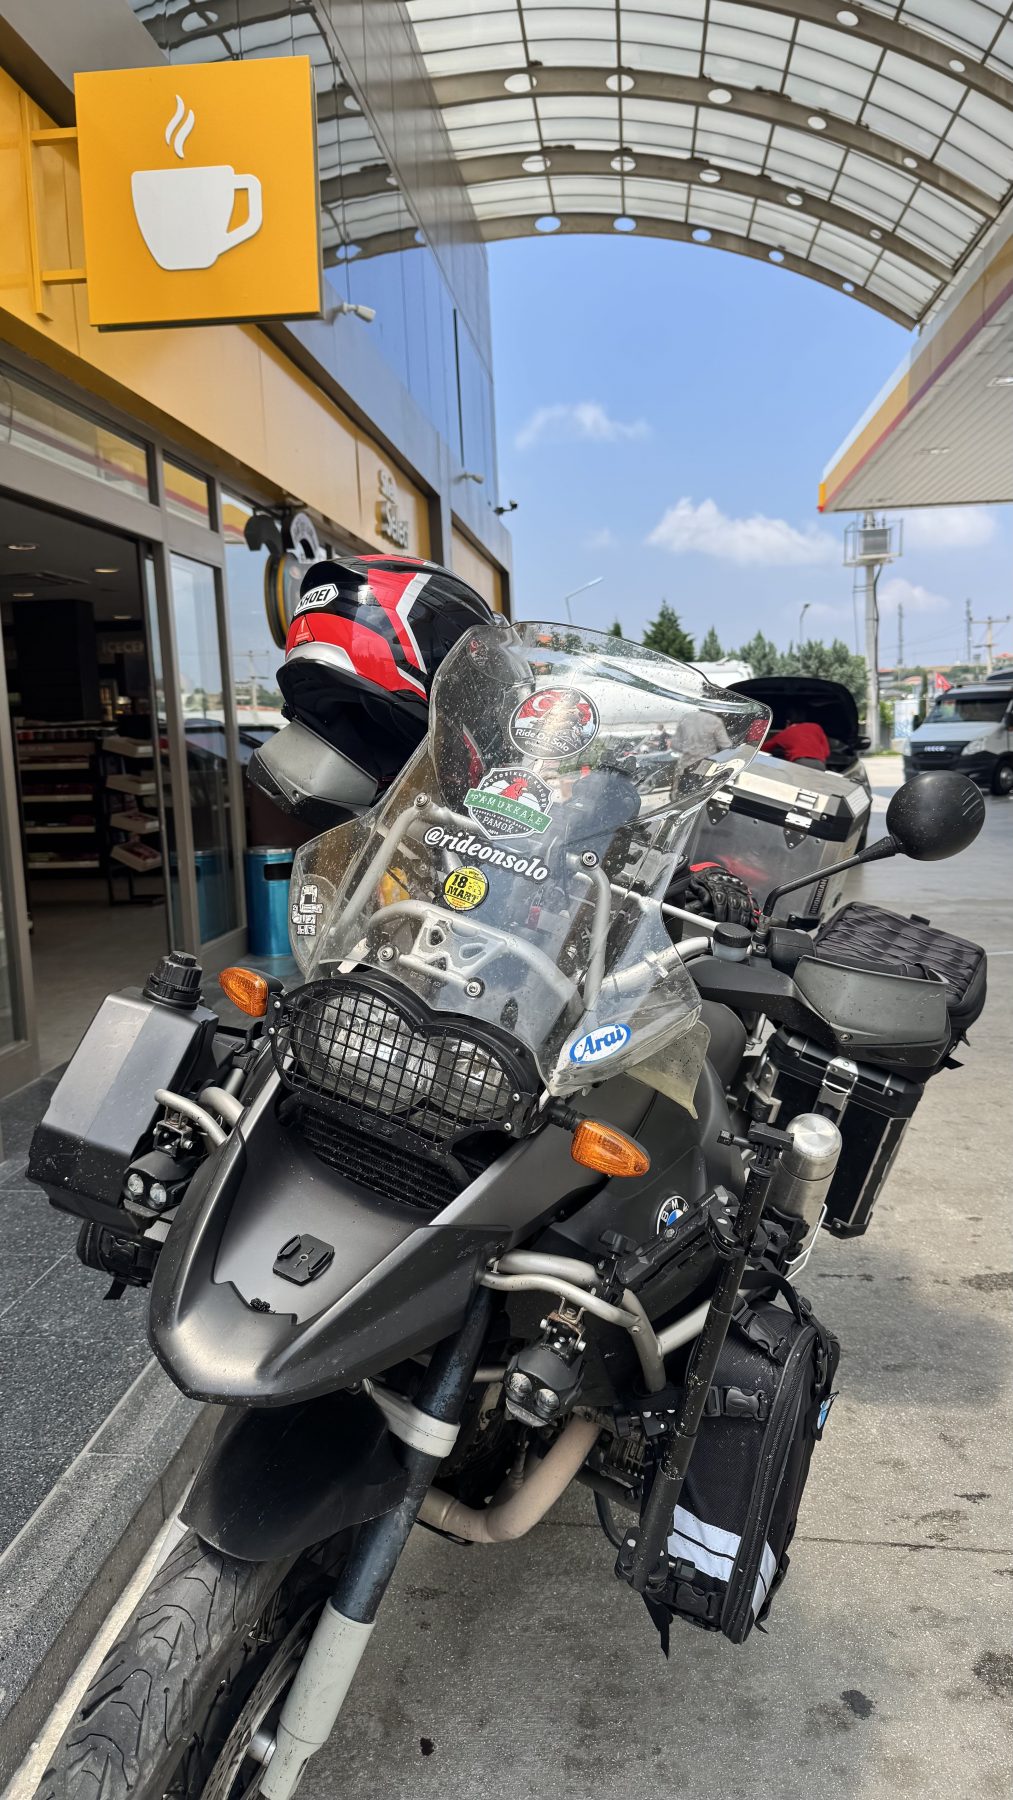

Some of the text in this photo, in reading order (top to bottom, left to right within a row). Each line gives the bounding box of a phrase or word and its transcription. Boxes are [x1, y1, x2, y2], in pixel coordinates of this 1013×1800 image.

[515, 728, 536, 738] Ride
[537, 732, 550, 741] On
[552, 737, 570, 752] Solo
[471, 793, 543, 826] PAMUKKALE
[424, 826, 549, 881] @rideonsolo
[446, 885, 478, 904] MART
[451, 874, 469, 889] 18
[577, 1024, 624, 1061] Arai
